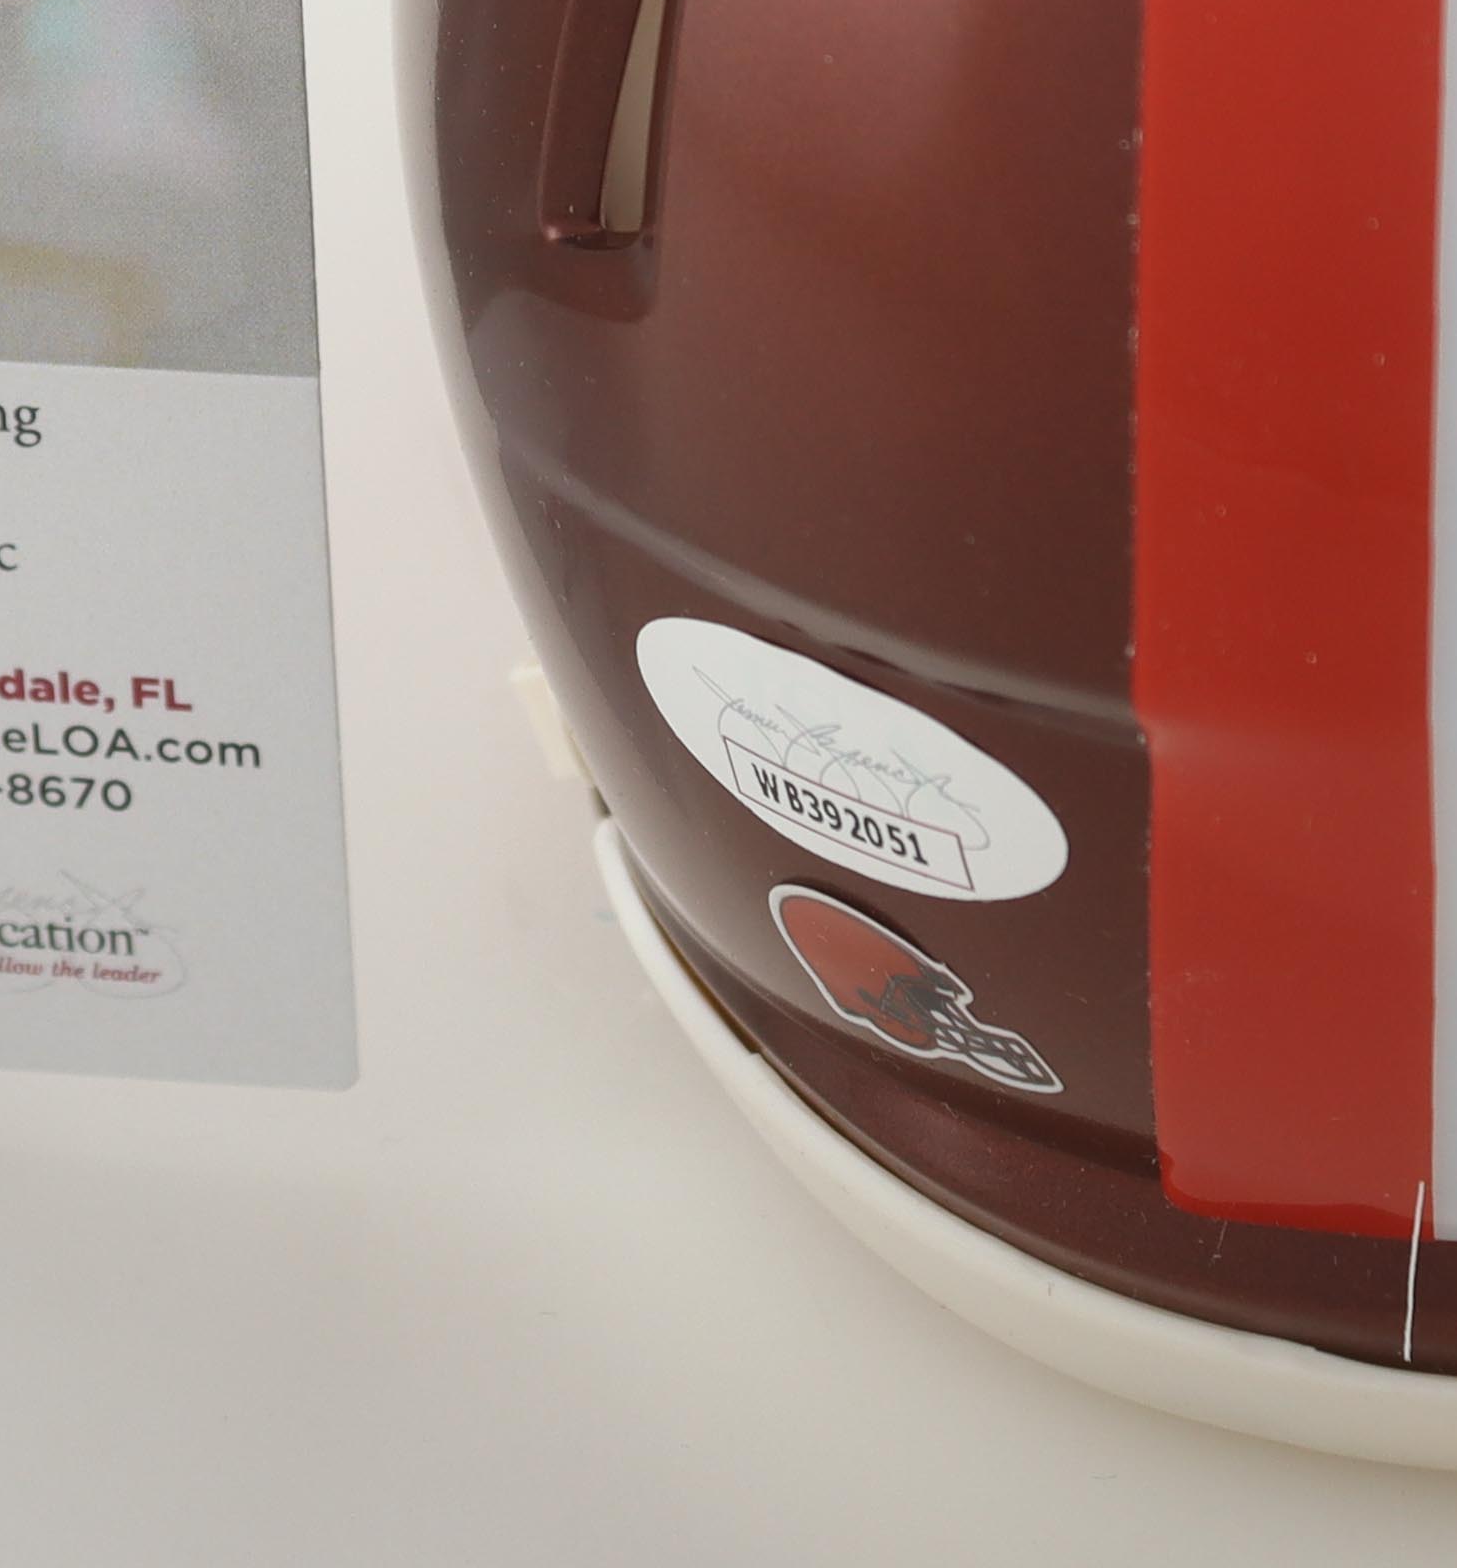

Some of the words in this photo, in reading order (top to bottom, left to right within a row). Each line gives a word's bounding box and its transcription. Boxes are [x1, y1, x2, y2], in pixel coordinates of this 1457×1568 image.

[131, 676, 193, 712] FL
[751, 763, 930, 866] WB392051
[51, 960, 85, 981] the
[91, 965, 162, 984] leader
